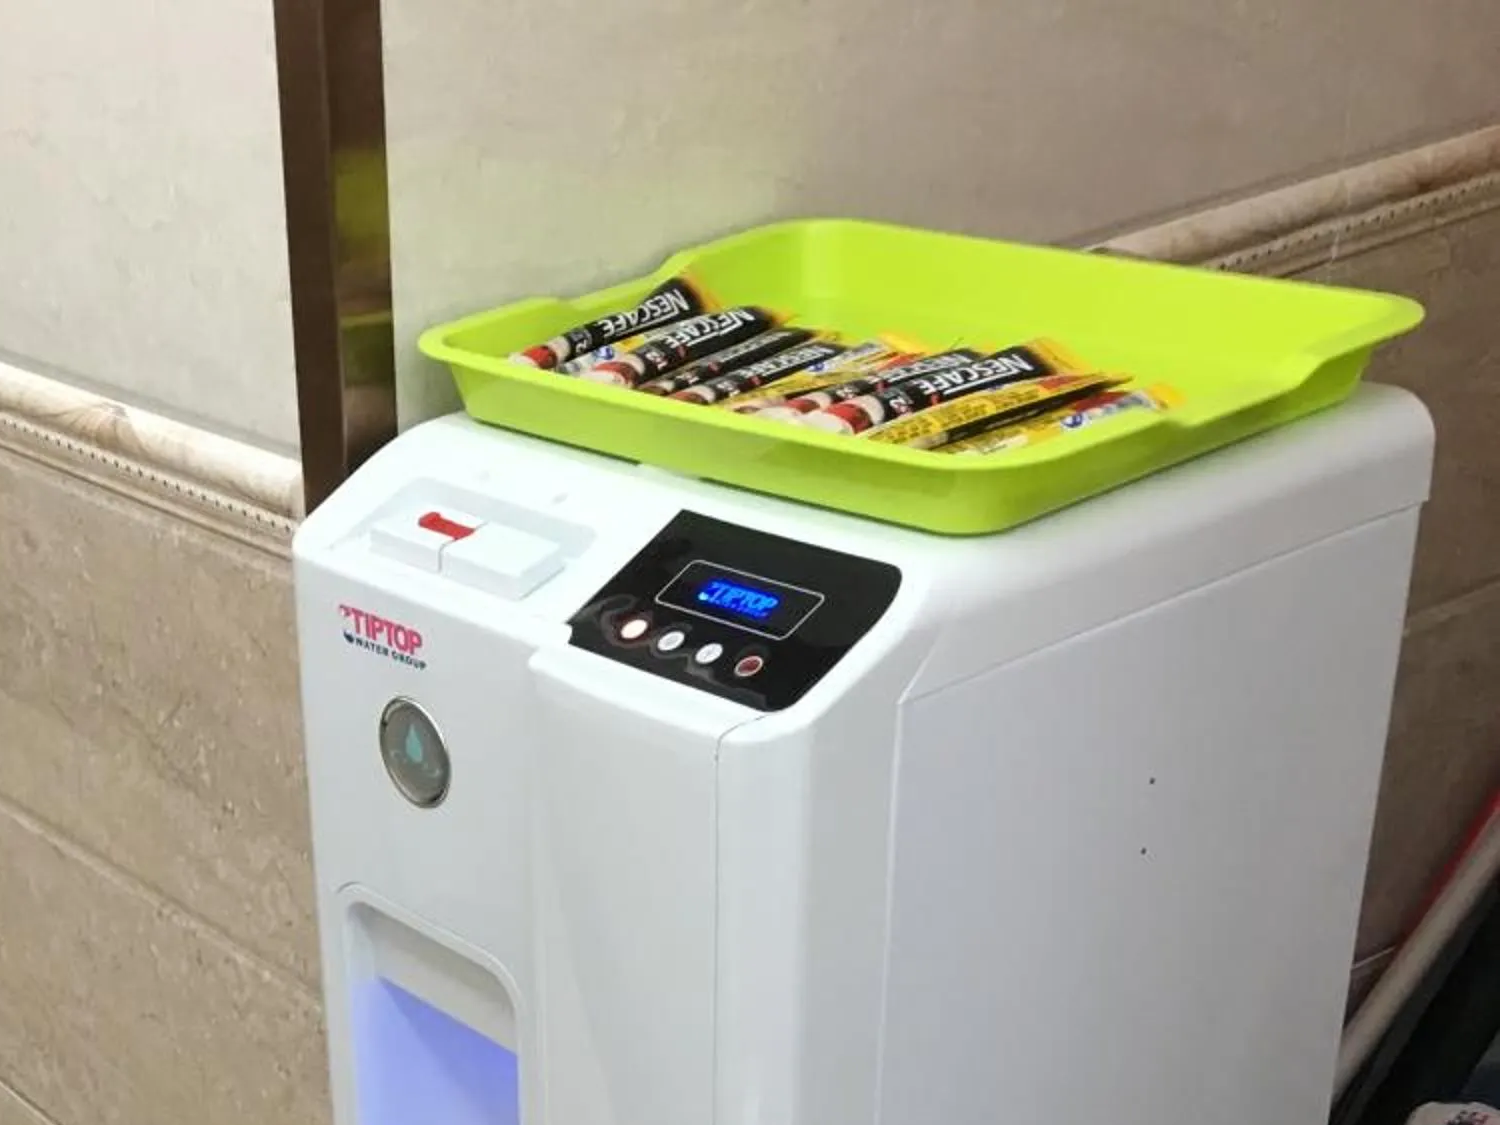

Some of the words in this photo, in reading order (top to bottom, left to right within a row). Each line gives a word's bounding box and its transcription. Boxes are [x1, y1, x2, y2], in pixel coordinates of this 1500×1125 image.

[349, 606, 423, 655] TIPTOP
[355, 637, 389, 656] WATER
[391, 651, 427, 670] GROUP
